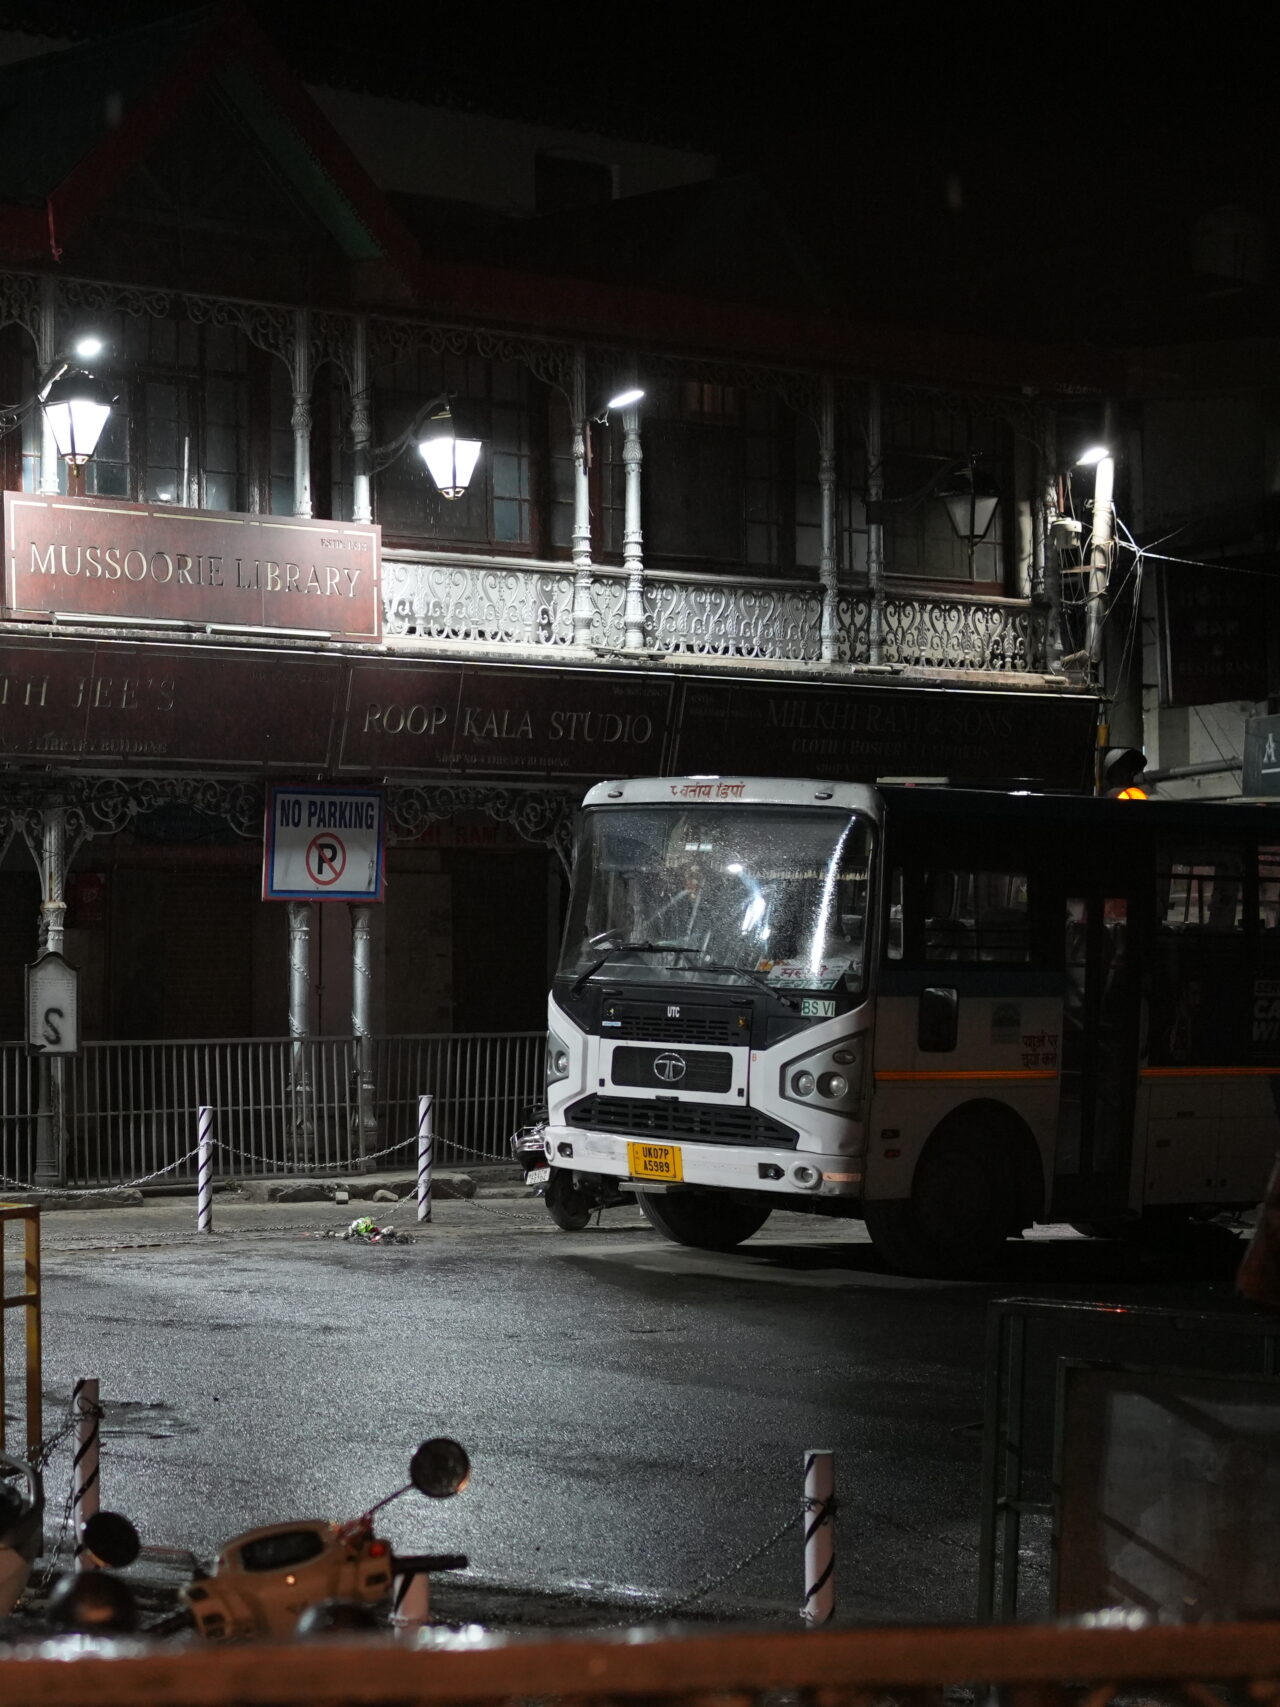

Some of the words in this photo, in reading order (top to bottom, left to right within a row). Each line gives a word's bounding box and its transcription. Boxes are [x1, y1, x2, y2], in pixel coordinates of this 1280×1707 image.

[30, 542, 224, 588] MUSSOORIE
[235, 557, 361, 598] LIBRARY
[72, 674, 177, 712] JEE'S
[363, 703, 448, 736] ROOP
[463, 706, 534, 740] KALA
[548, 710, 652, 745] STUDIO
[764, 698, 858, 732] MILKHI
[925, 707, 945, 736] &
[949, 706, 1013, 739] SONS
[280, 799, 302, 827] NO
[308, 801, 375, 829] PARKING
[319, 842, 337, 875] P
[667, 1005, 680, 1018] UTC
[802, 1000, 819, 1015] BS
[822, 1001, 834, 1016] VI
[642, 1146, 669, 1160] UK07P
[643, 1160, 670, 1173] A5989
